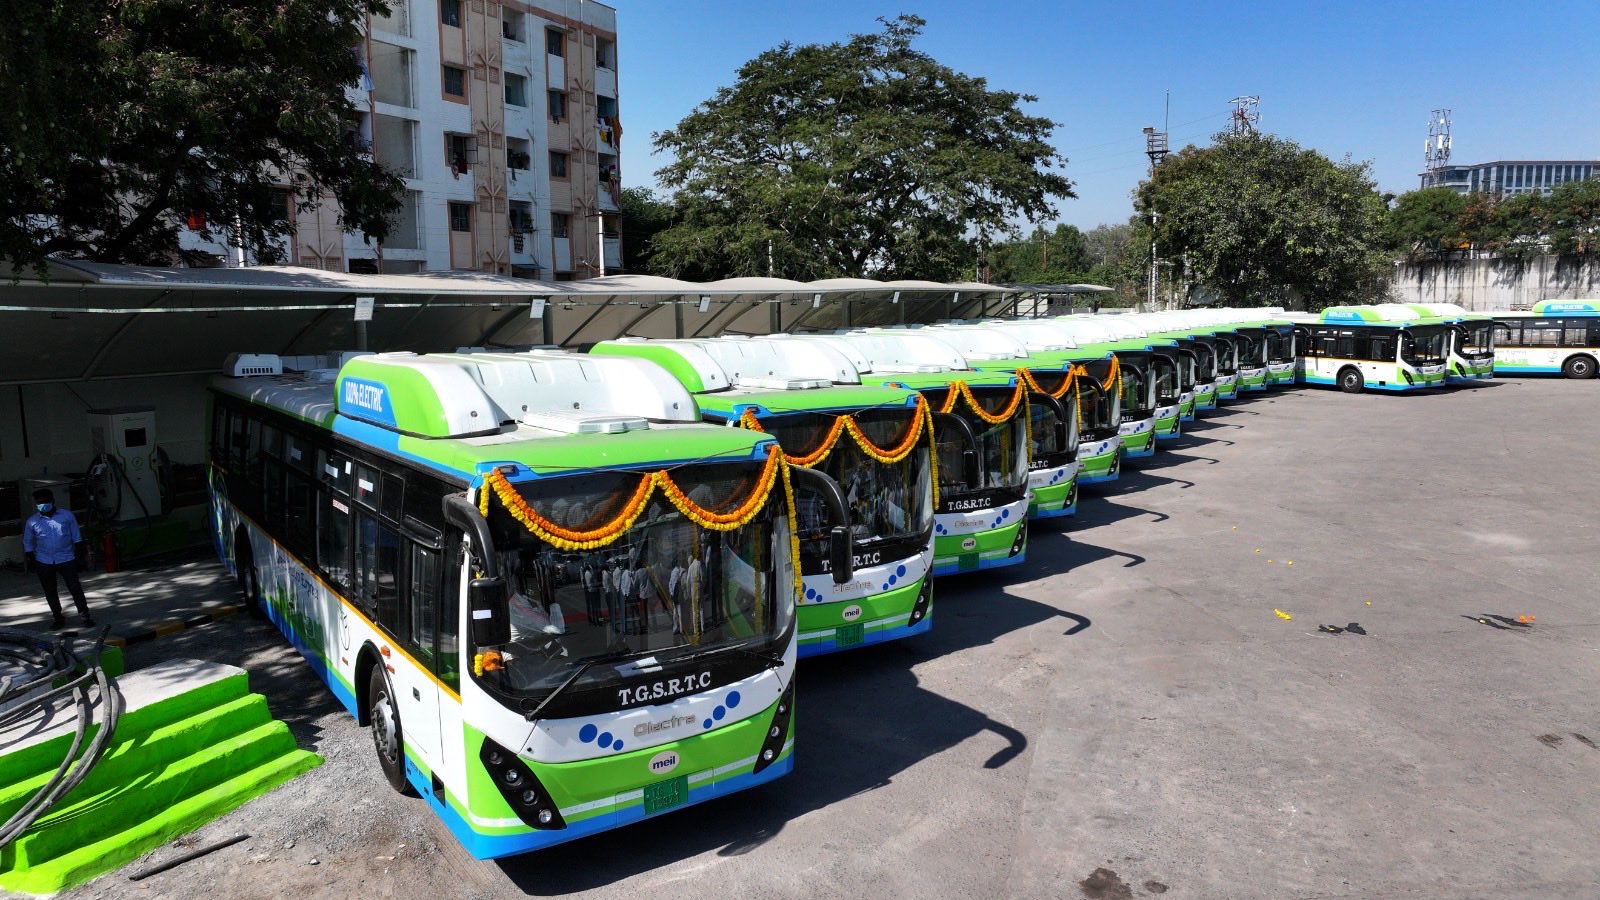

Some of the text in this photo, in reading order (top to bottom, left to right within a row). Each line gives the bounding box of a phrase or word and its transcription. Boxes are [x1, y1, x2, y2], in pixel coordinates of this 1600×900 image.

[359, 383, 384, 413] ELECTRIC
[947, 497, 992, 511] T.G.S.R.T.C
[844, 607, 860, 617] meil
[618, 671, 712, 706] T.G.S.R.T.C
[652, 755, 676, 770] meil
